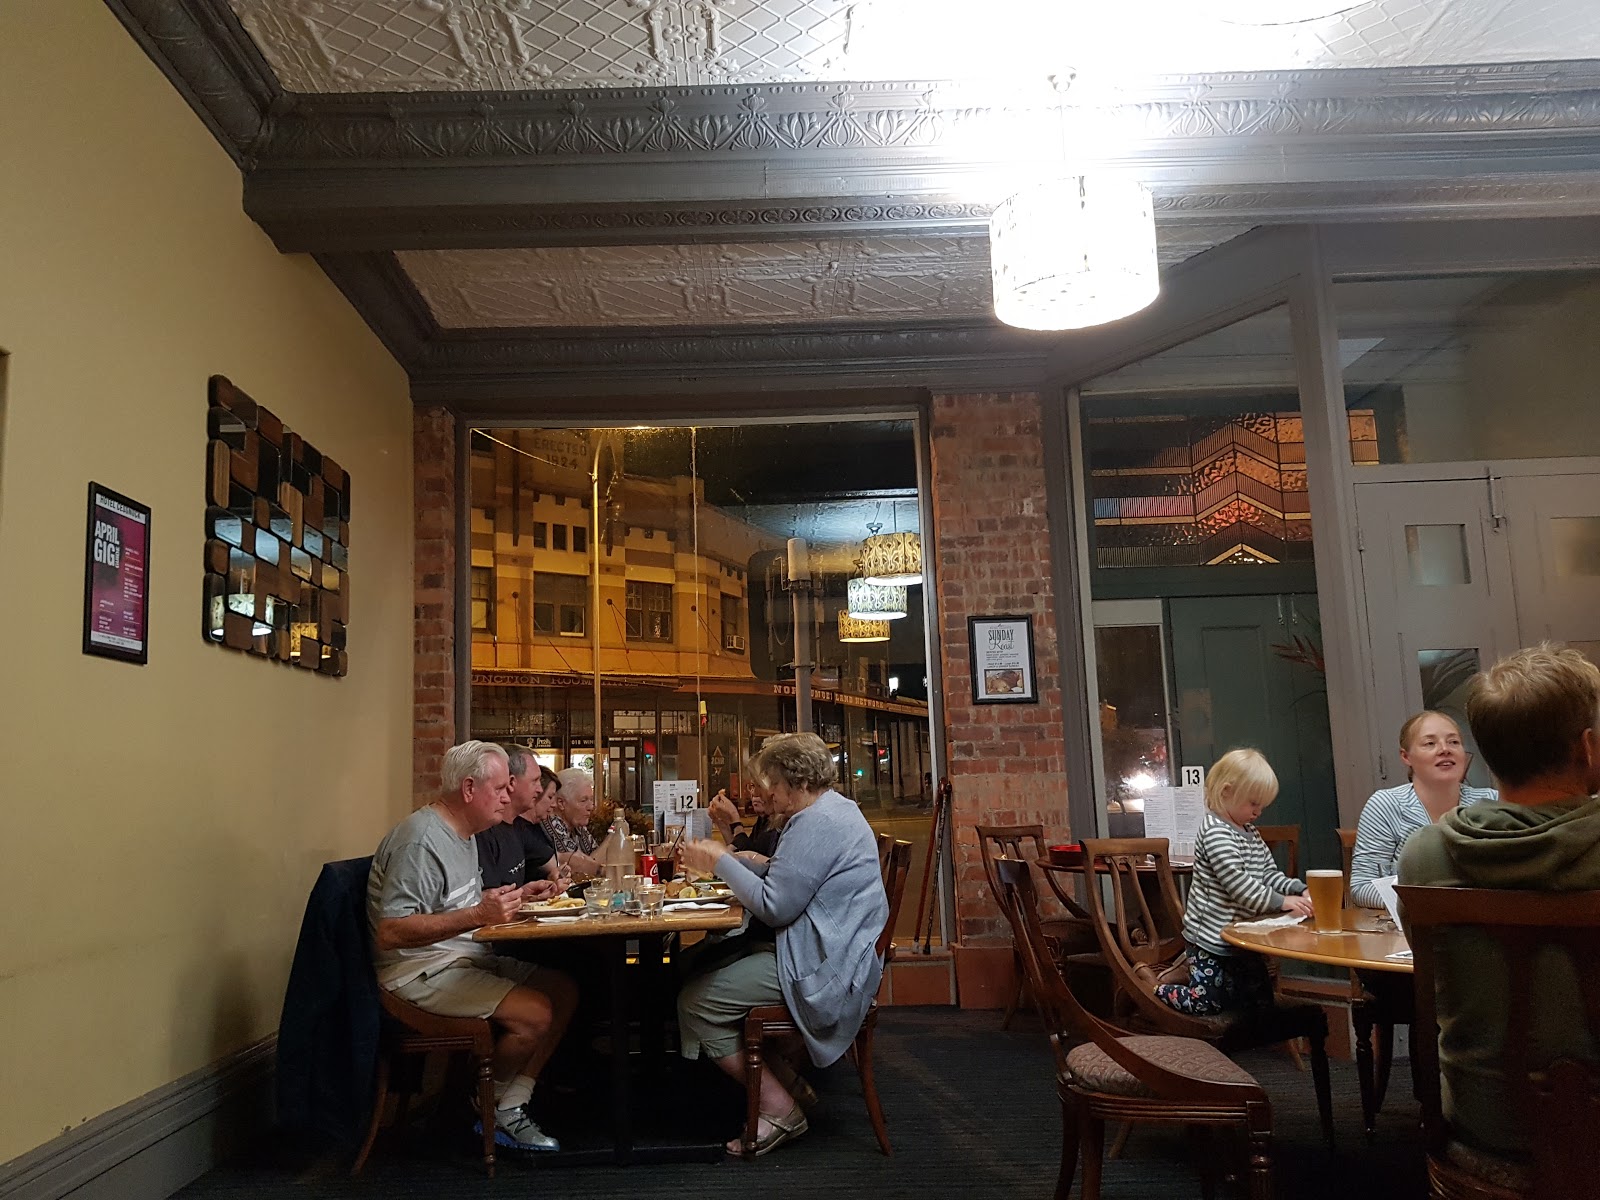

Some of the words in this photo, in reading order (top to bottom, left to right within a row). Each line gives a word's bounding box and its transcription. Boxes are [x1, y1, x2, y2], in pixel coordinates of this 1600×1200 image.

[534, 438, 587, 456] ERECTED
[95, 520, 120, 545] APRIL
[94, 538, 115, 567] GIG
[988, 629, 1015, 641] SUNDAY
[472, 674, 541, 686] UNCTION
[1186, 769, 1200, 785] 13
[680, 795, 694, 809] 12
